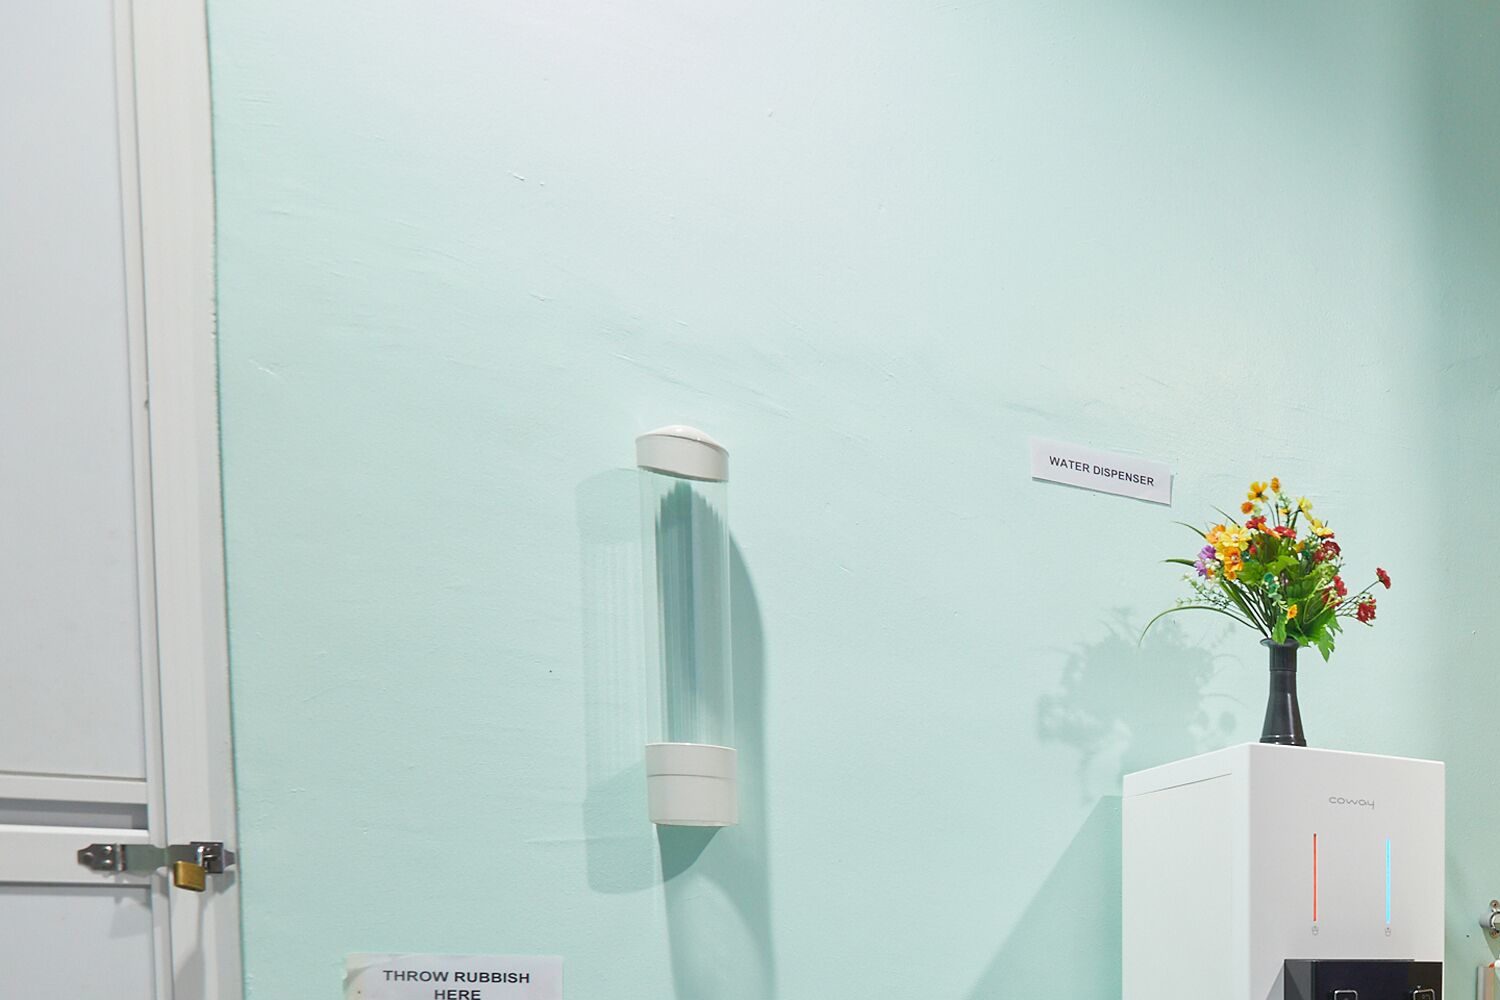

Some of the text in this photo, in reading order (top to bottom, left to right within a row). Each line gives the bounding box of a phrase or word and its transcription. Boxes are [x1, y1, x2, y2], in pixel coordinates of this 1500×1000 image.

[1049, 455, 1154, 486] WATER DISPENSER
[1328, 796, 1375, 810] coway
[383, 970, 530, 984] THROW RUBBISH
[434, 989, 481, 1000] HERE
